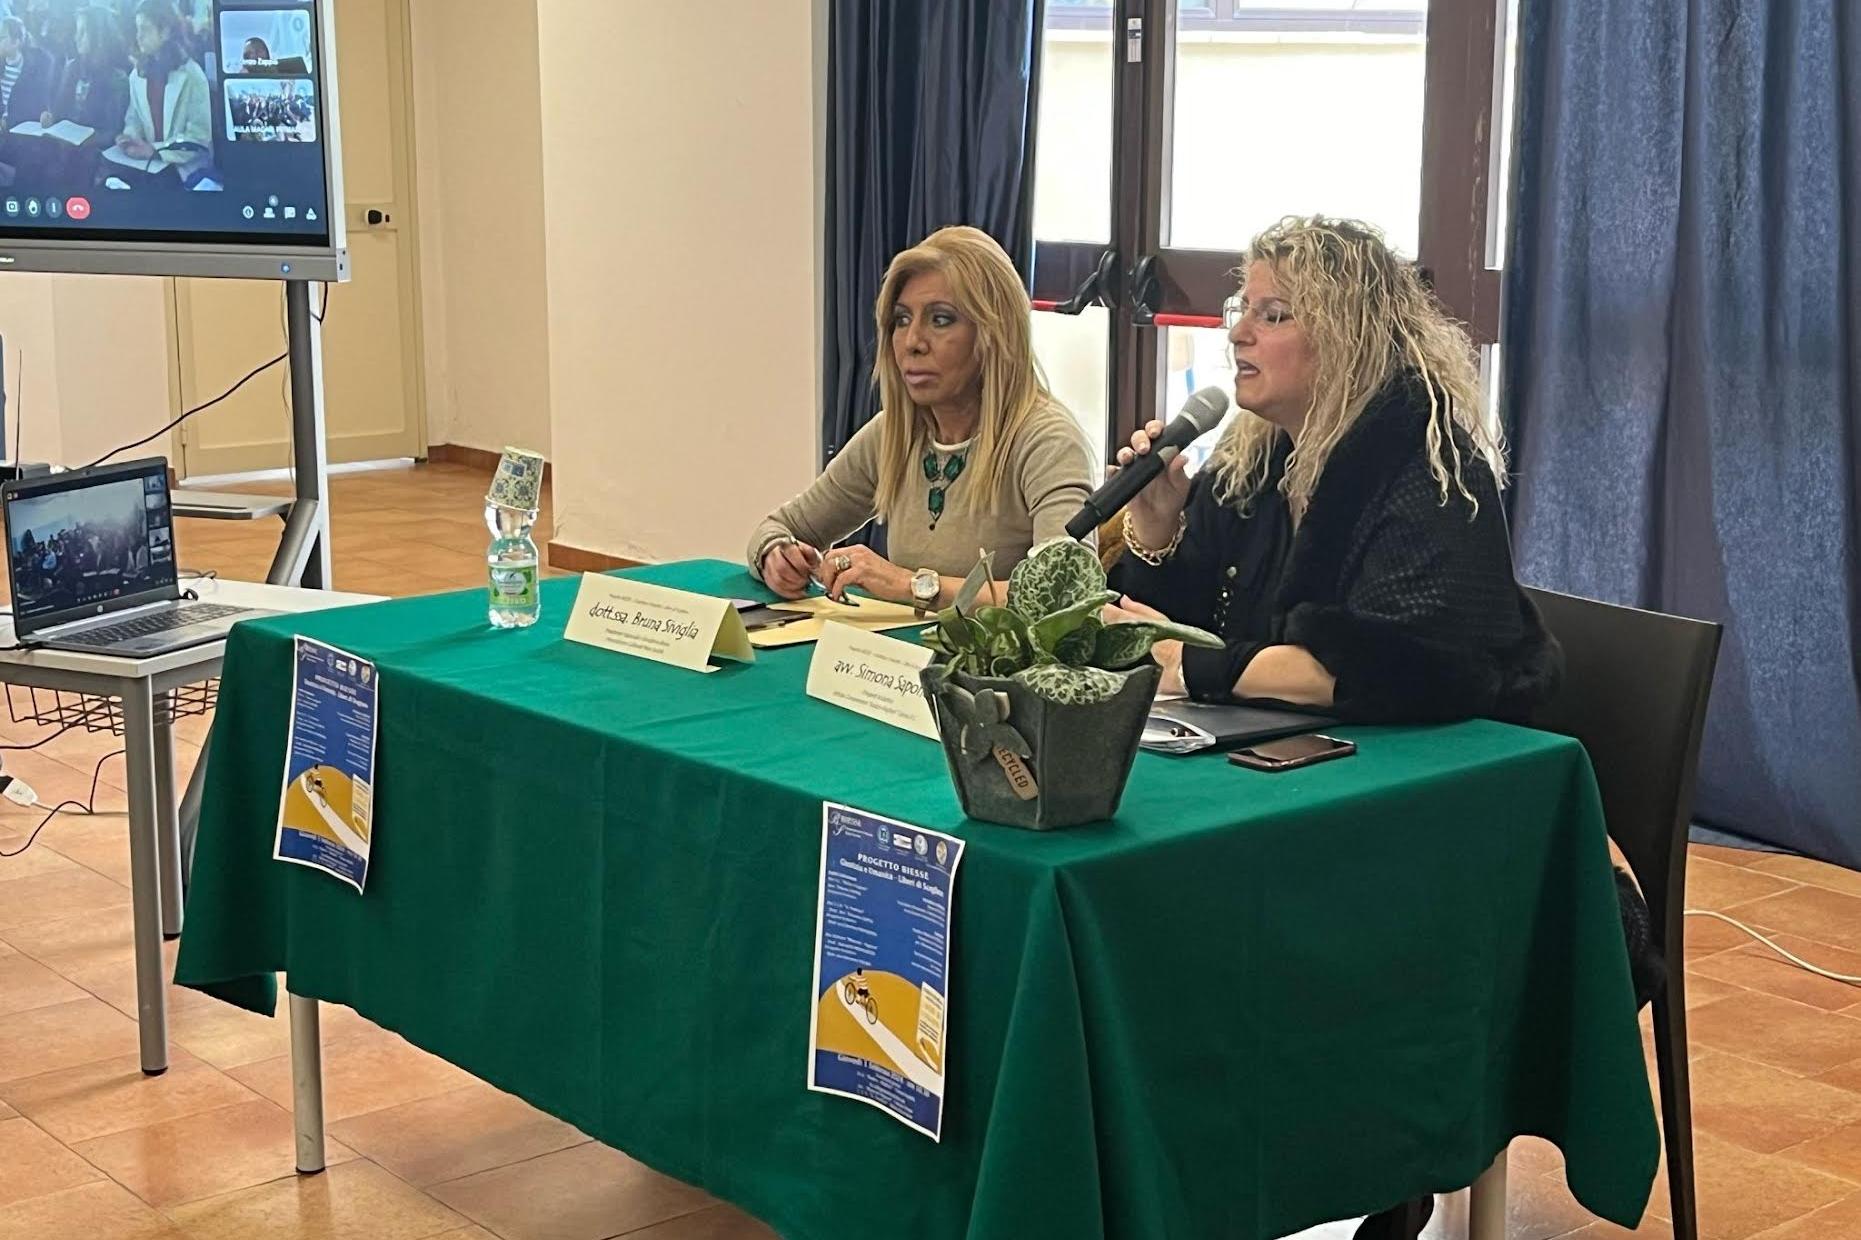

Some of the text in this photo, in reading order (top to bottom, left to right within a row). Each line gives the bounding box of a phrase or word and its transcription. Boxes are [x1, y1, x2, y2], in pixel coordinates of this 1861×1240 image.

[631, 611, 663, 632] Bruna
[662, 619, 699, 641] Siviglia
[855, 663, 895, 689] Simona
[857, 852, 900, 871] PROGETTO
[901, 865, 929, 880] BIESSE
